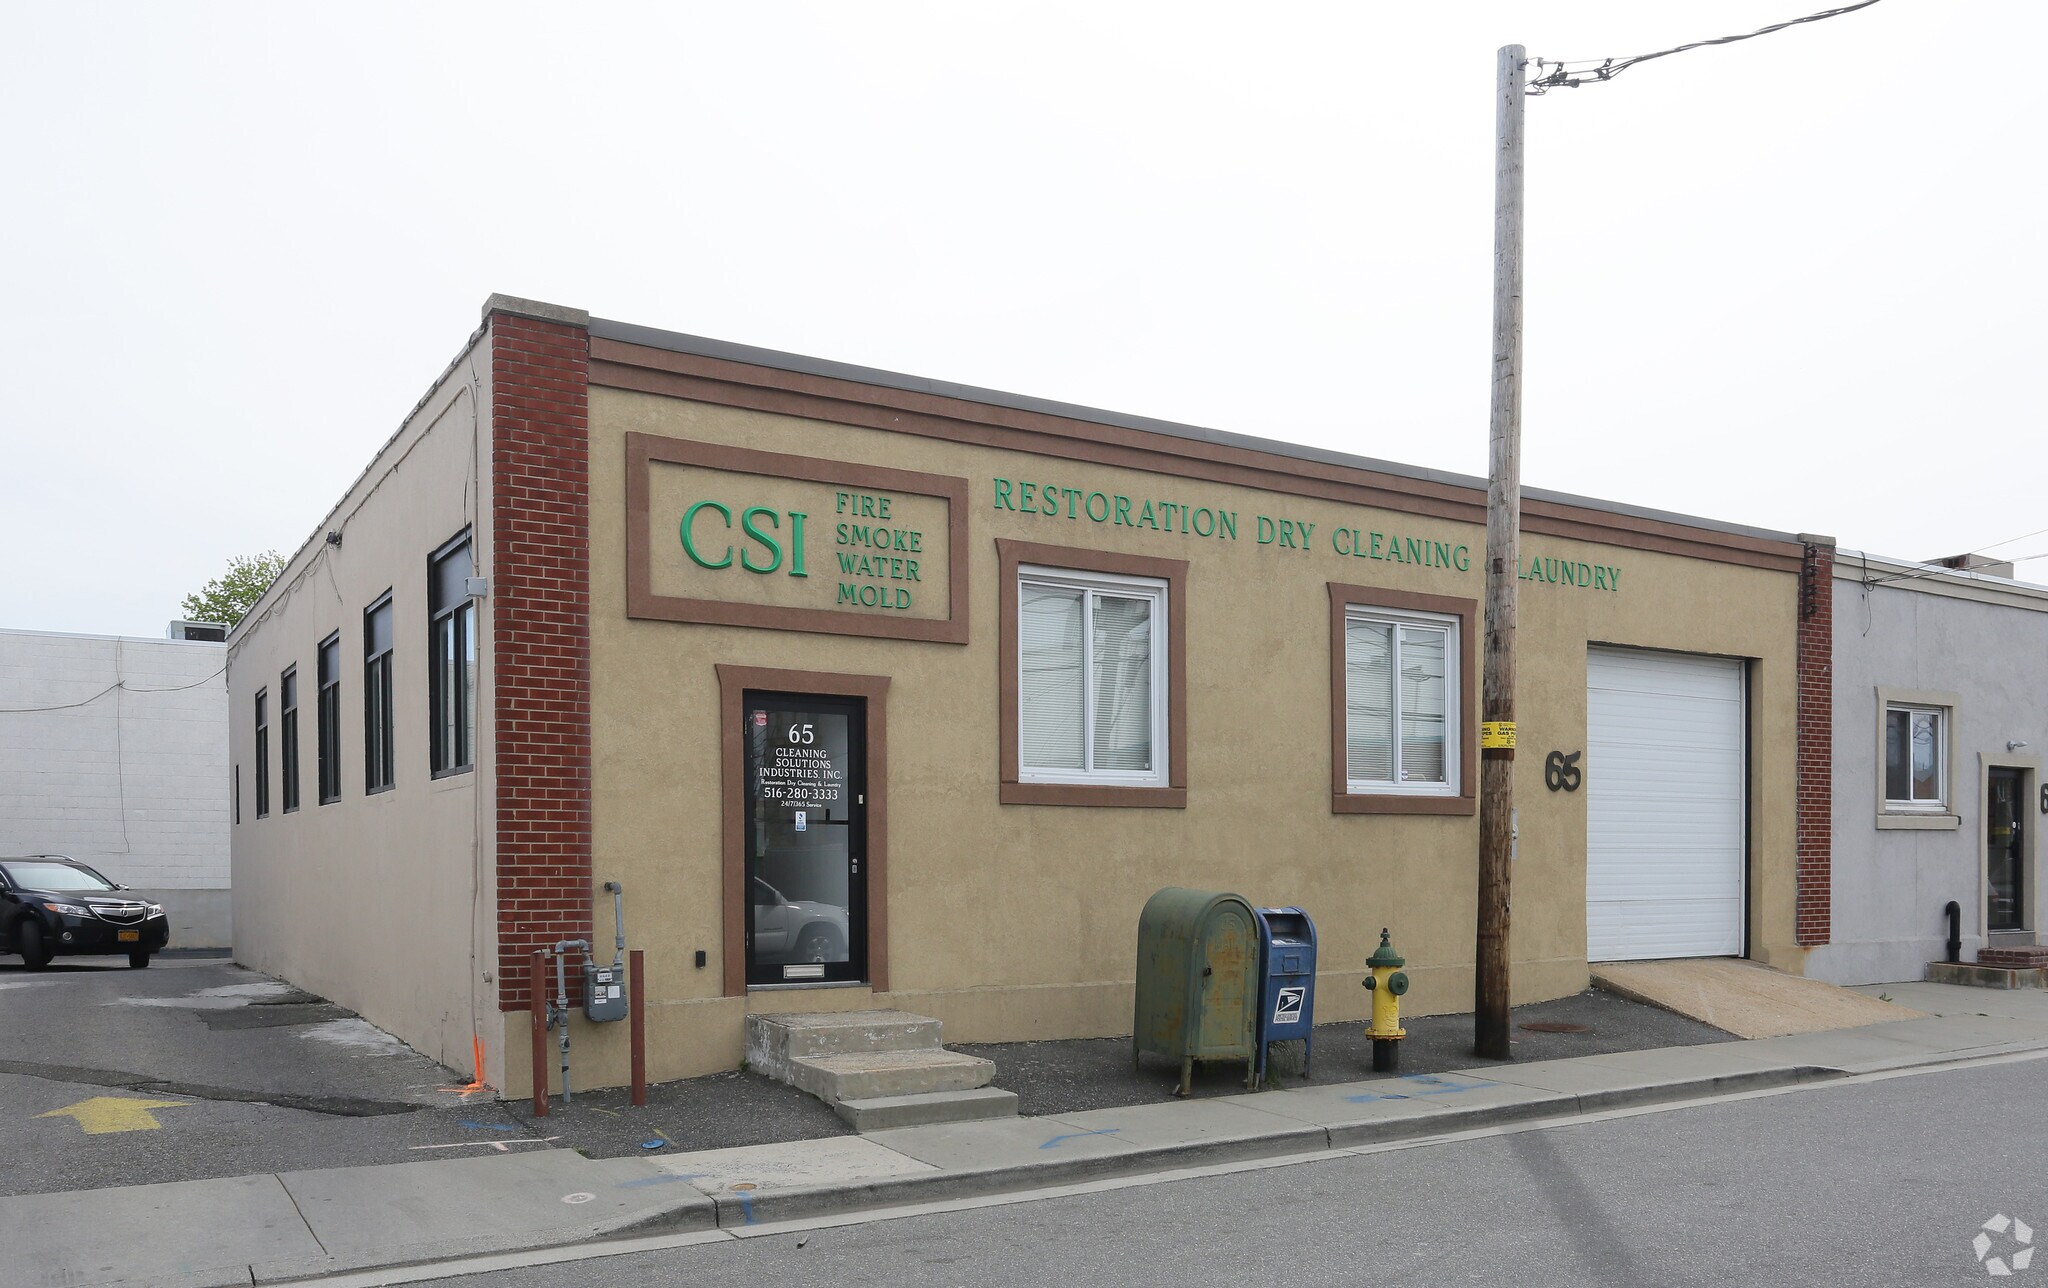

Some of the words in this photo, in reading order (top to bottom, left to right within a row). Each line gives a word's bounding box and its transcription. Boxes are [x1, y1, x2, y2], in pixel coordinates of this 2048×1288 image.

[836, 491, 893, 519] FIRE
[679, 499, 808, 578] CSI
[836, 523, 923, 553] SMOKE
[993, 476, 1238, 540] RESTORATION
[1257, 514, 1317, 550] DRY
[1332, 527, 1471, 573] CLEANING
[1518, 555, 1622, 591] LAUNDRY
[836, 551, 922, 581] WATER
[837, 581, 913, 610] MOLD
[788, 723, 814, 745] 65
[775, 747, 827, 759] CLEANING
[775, 757, 831, 769] SOLUTIONS
[787, 779, 796, 787] Dry
[797, 779, 817, 787] Cleaning
[823, 770, 843, 780] INC.
[1545, 751, 1582, 793] 65
[764, 787, 838, 800] 516-280-3333
[780, 800, 806, 808] 24/7/365
